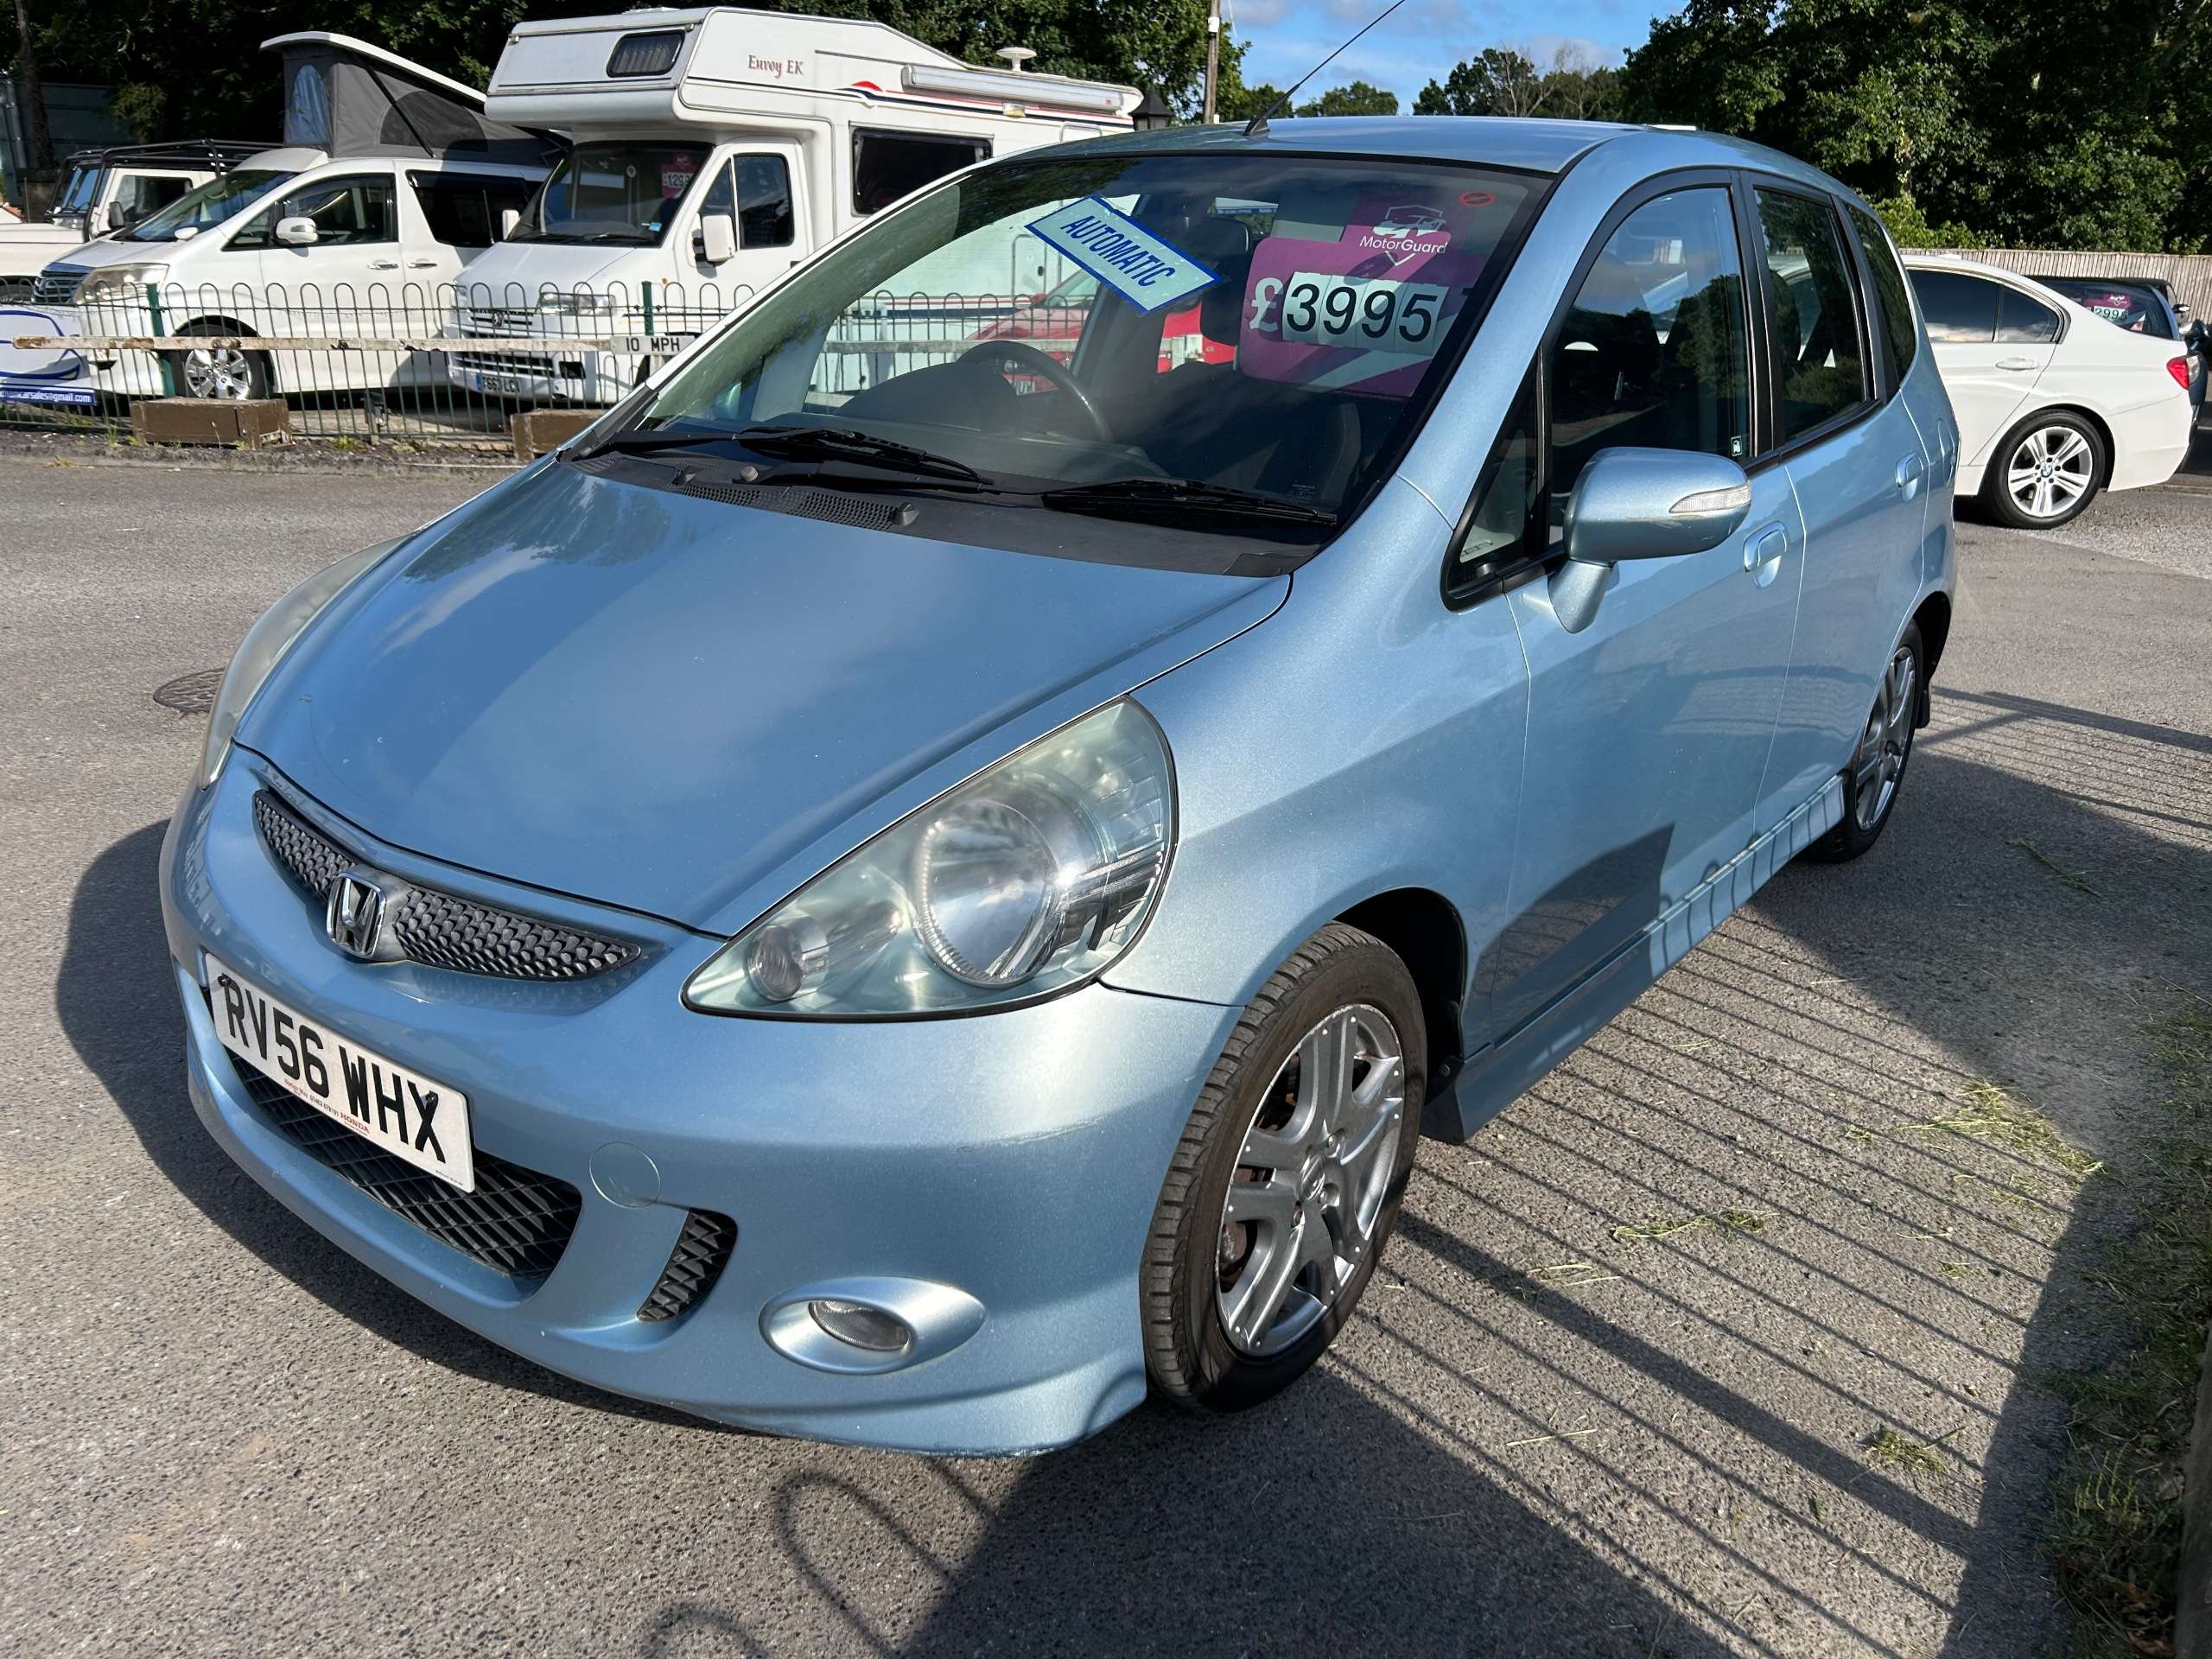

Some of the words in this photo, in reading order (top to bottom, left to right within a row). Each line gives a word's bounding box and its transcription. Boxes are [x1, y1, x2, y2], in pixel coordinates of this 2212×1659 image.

[748, 54, 782, 79] Envoy
[786, 60, 804, 76] EK
[1059, 215, 1176, 287] AUTOMATIC
[1359, 235, 1447, 255] MotorGuard
[626, 337, 639, 352] 10
[650, 337, 680, 352] MPH
[219, 974, 329, 1098] RV56
[339, 1045, 446, 1164] WHX
[340, 1111, 370, 1134] HONDA
